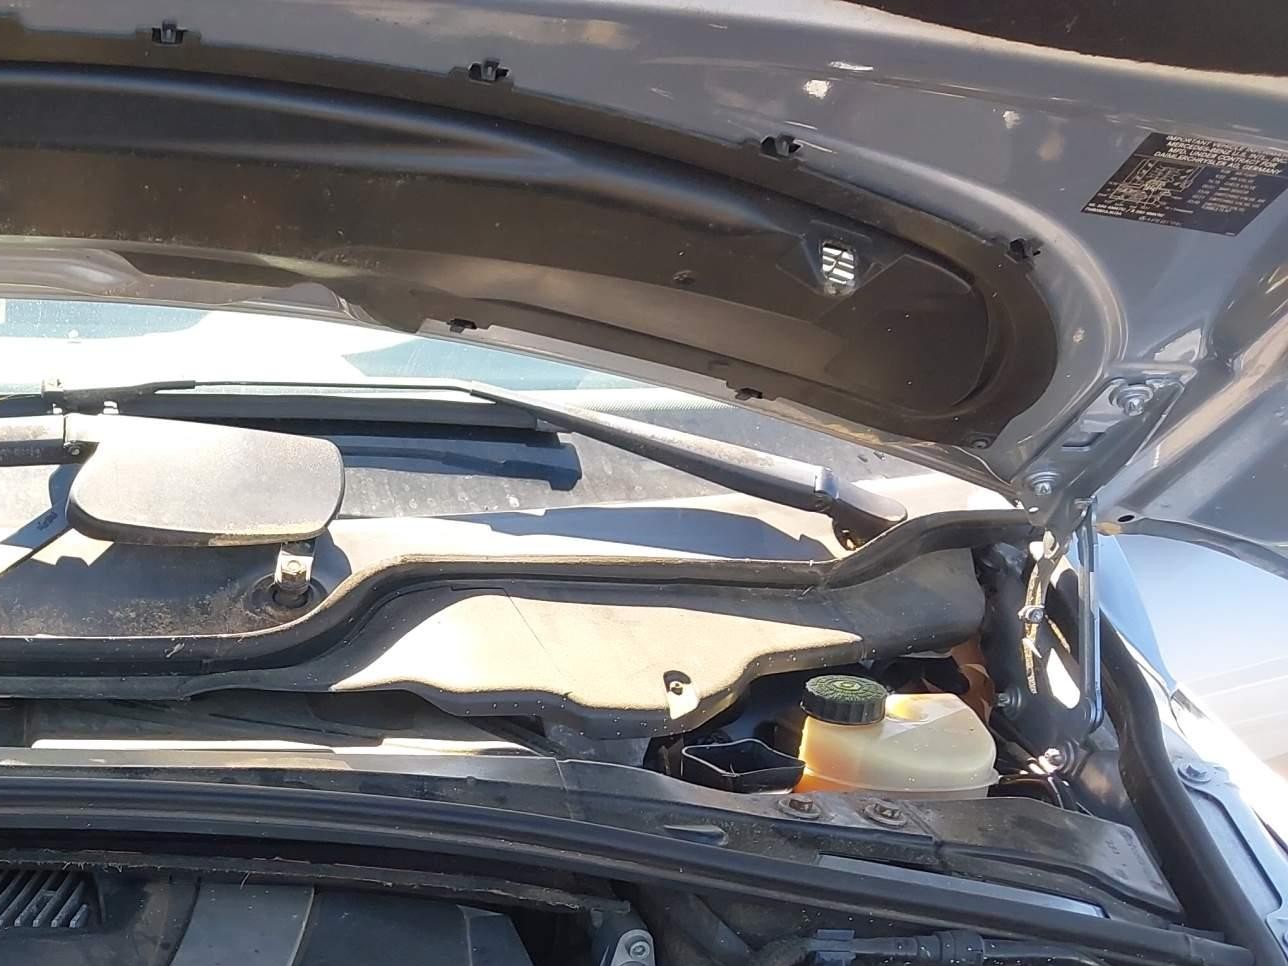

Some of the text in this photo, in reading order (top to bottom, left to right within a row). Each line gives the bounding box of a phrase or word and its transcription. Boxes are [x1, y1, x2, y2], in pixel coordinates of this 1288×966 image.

[1166, 135, 1211, 146] IMPORTANT
[1166, 141, 1232, 155] MERCEDES-BENZ
[1153, 151, 1228, 166] DAIMLERCHRYSLER
[1242, 164, 1283, 175] GERMANY
[1189, 150, 1218, 159] UNDER
[1217, 154, 1262, 165] CONTRACT
